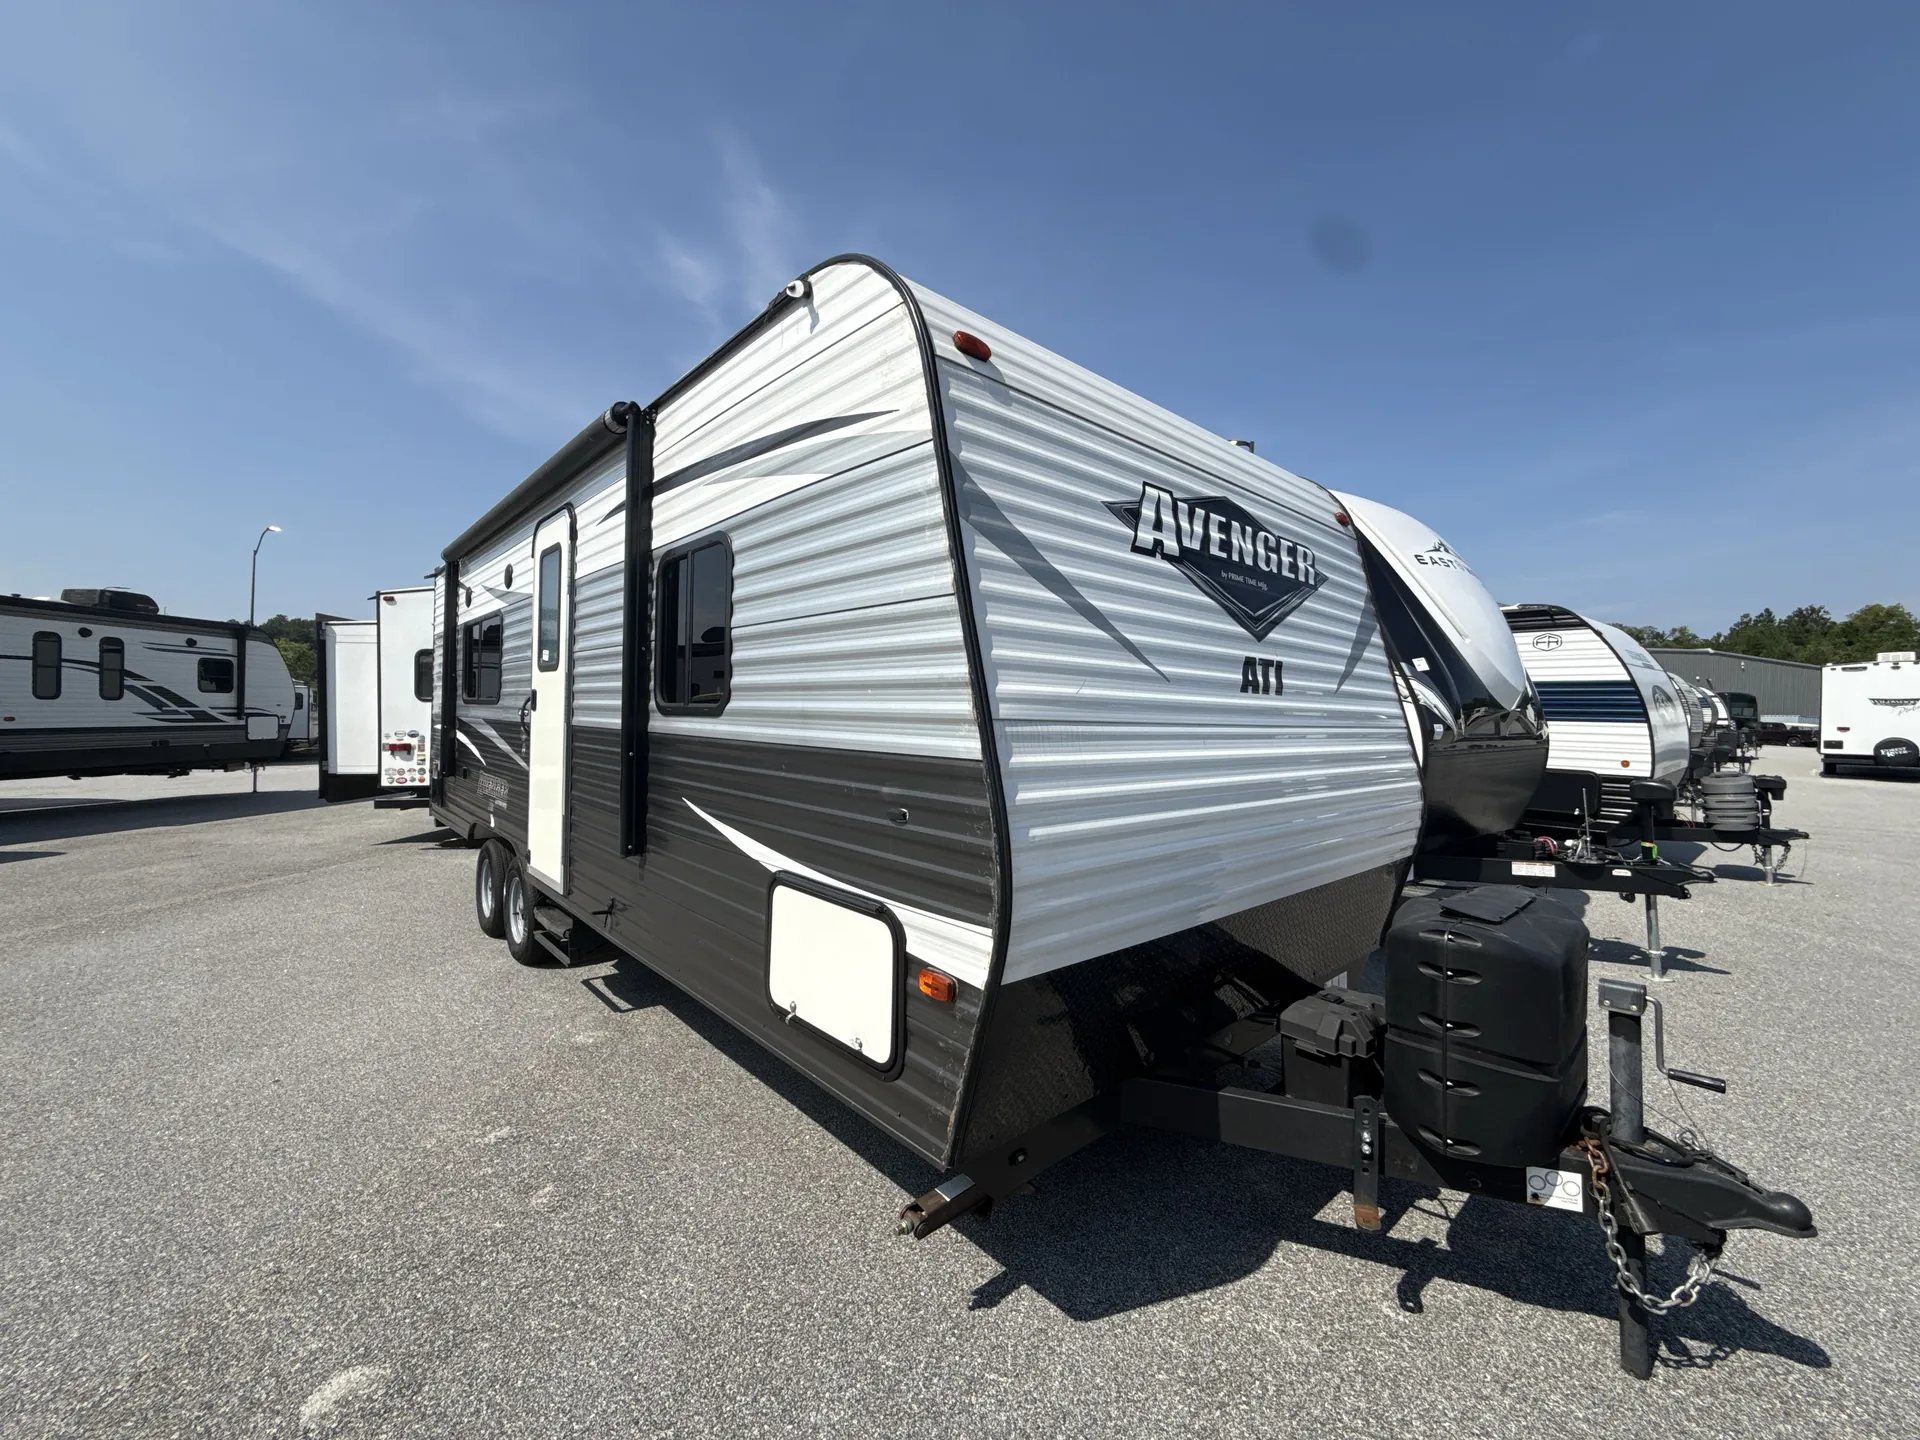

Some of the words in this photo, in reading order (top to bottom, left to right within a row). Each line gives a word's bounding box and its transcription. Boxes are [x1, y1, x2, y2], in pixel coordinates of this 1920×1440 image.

[1133, 483, 1316, 587] AVENGER
[1228, 572, 1244, 583] PRIME
[1245, 577, 1257, 587] TIME
[1240, 656, 1284, 696] ATI
